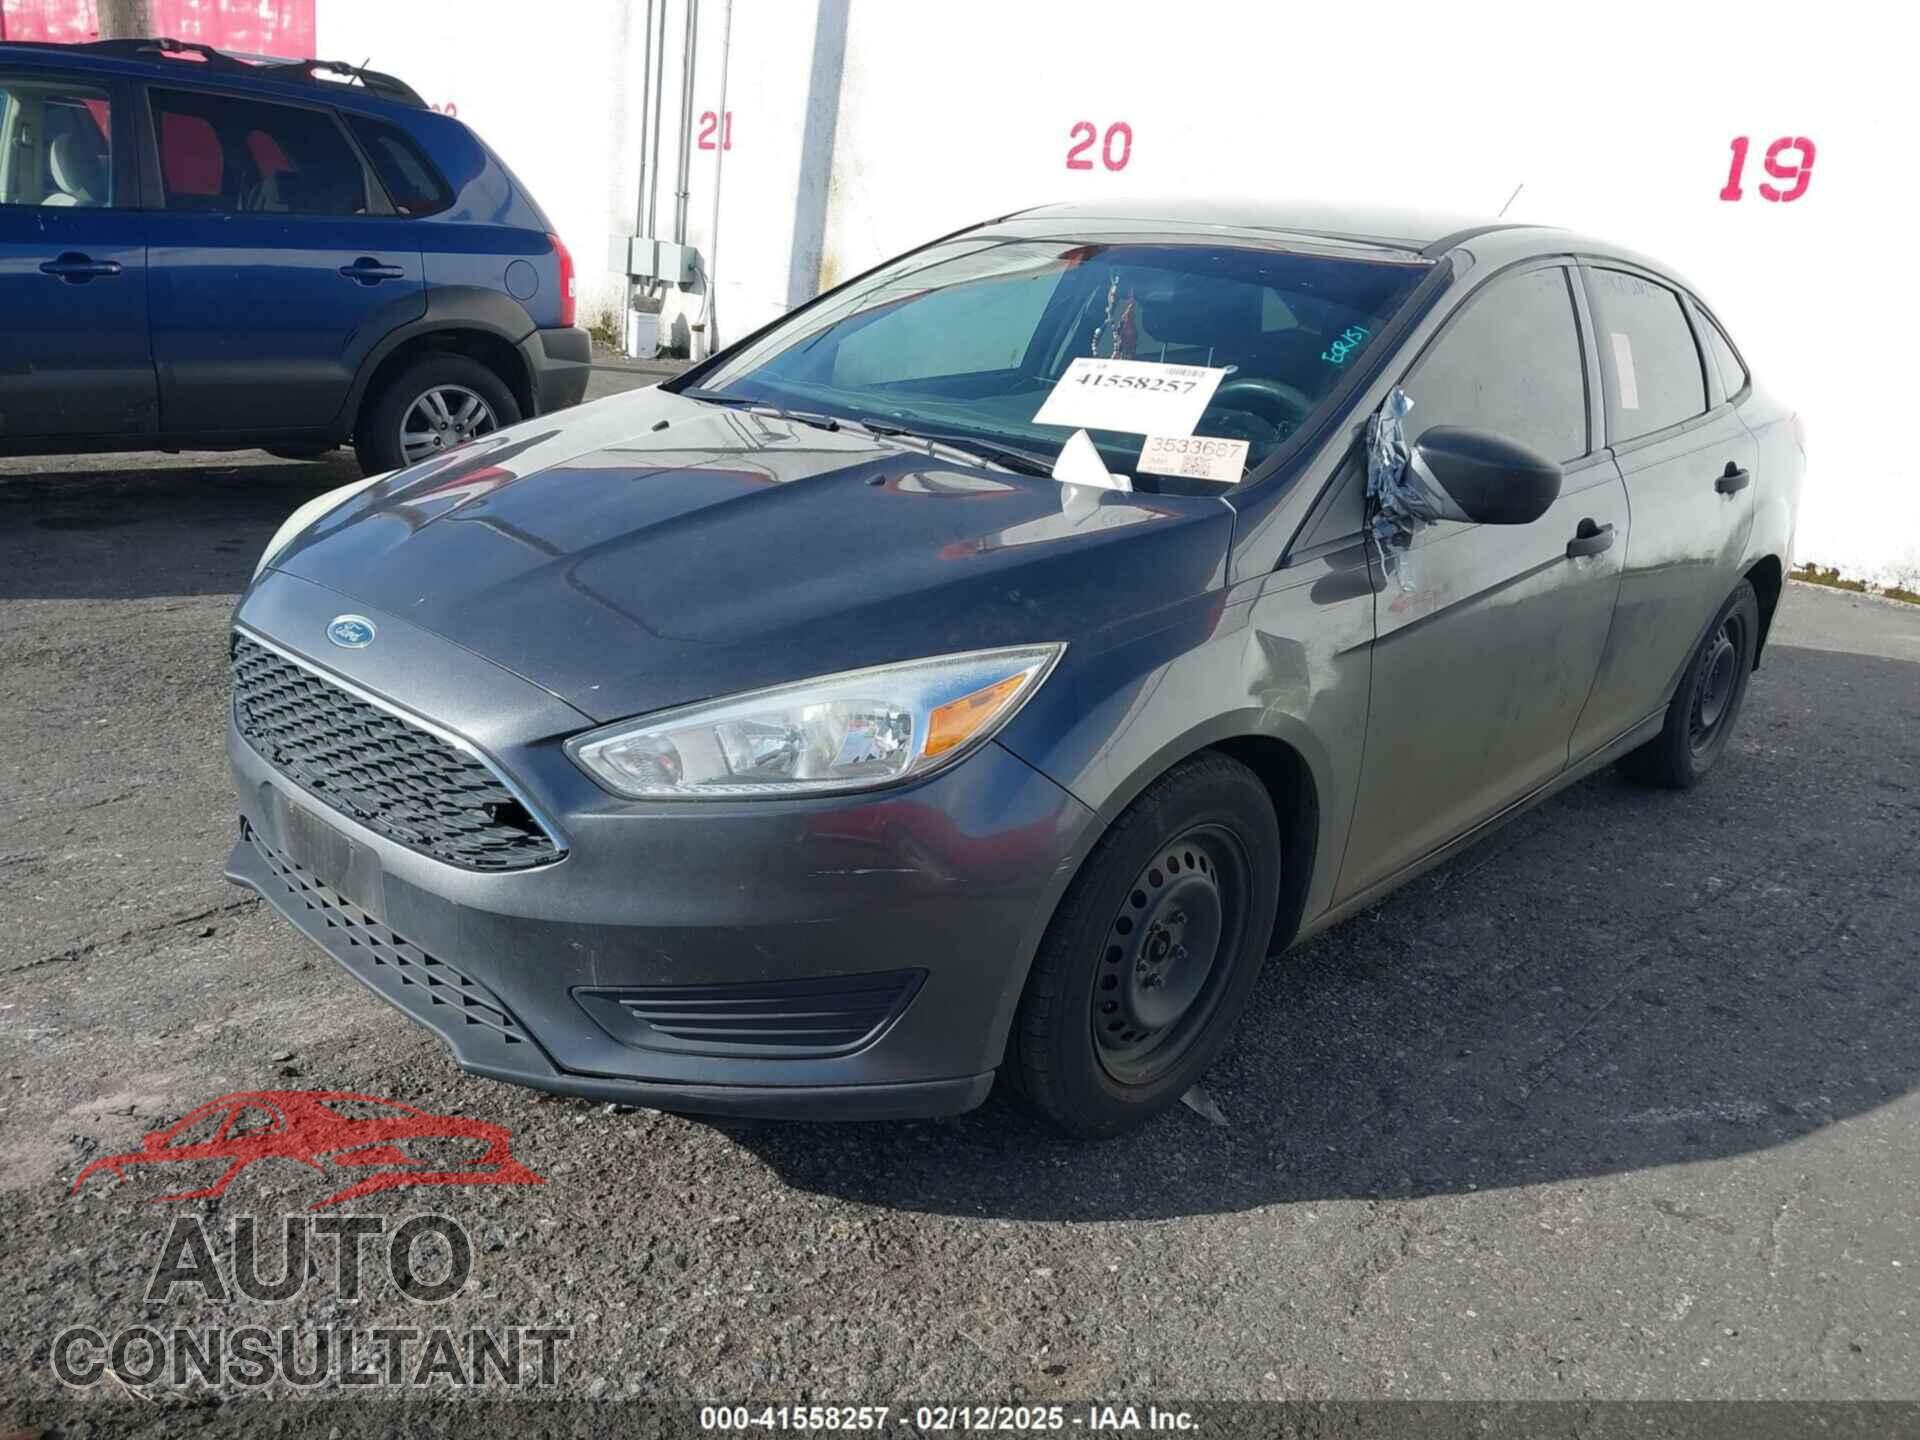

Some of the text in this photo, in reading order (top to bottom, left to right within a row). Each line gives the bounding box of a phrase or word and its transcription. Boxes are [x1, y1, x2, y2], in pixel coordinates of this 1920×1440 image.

[698, 112, 732, 151] 21
[1066, 121, 1133, 171] 20
[1719, 136, 1816, 203] 19
[1075, 372, 1198, 395] 41558257
